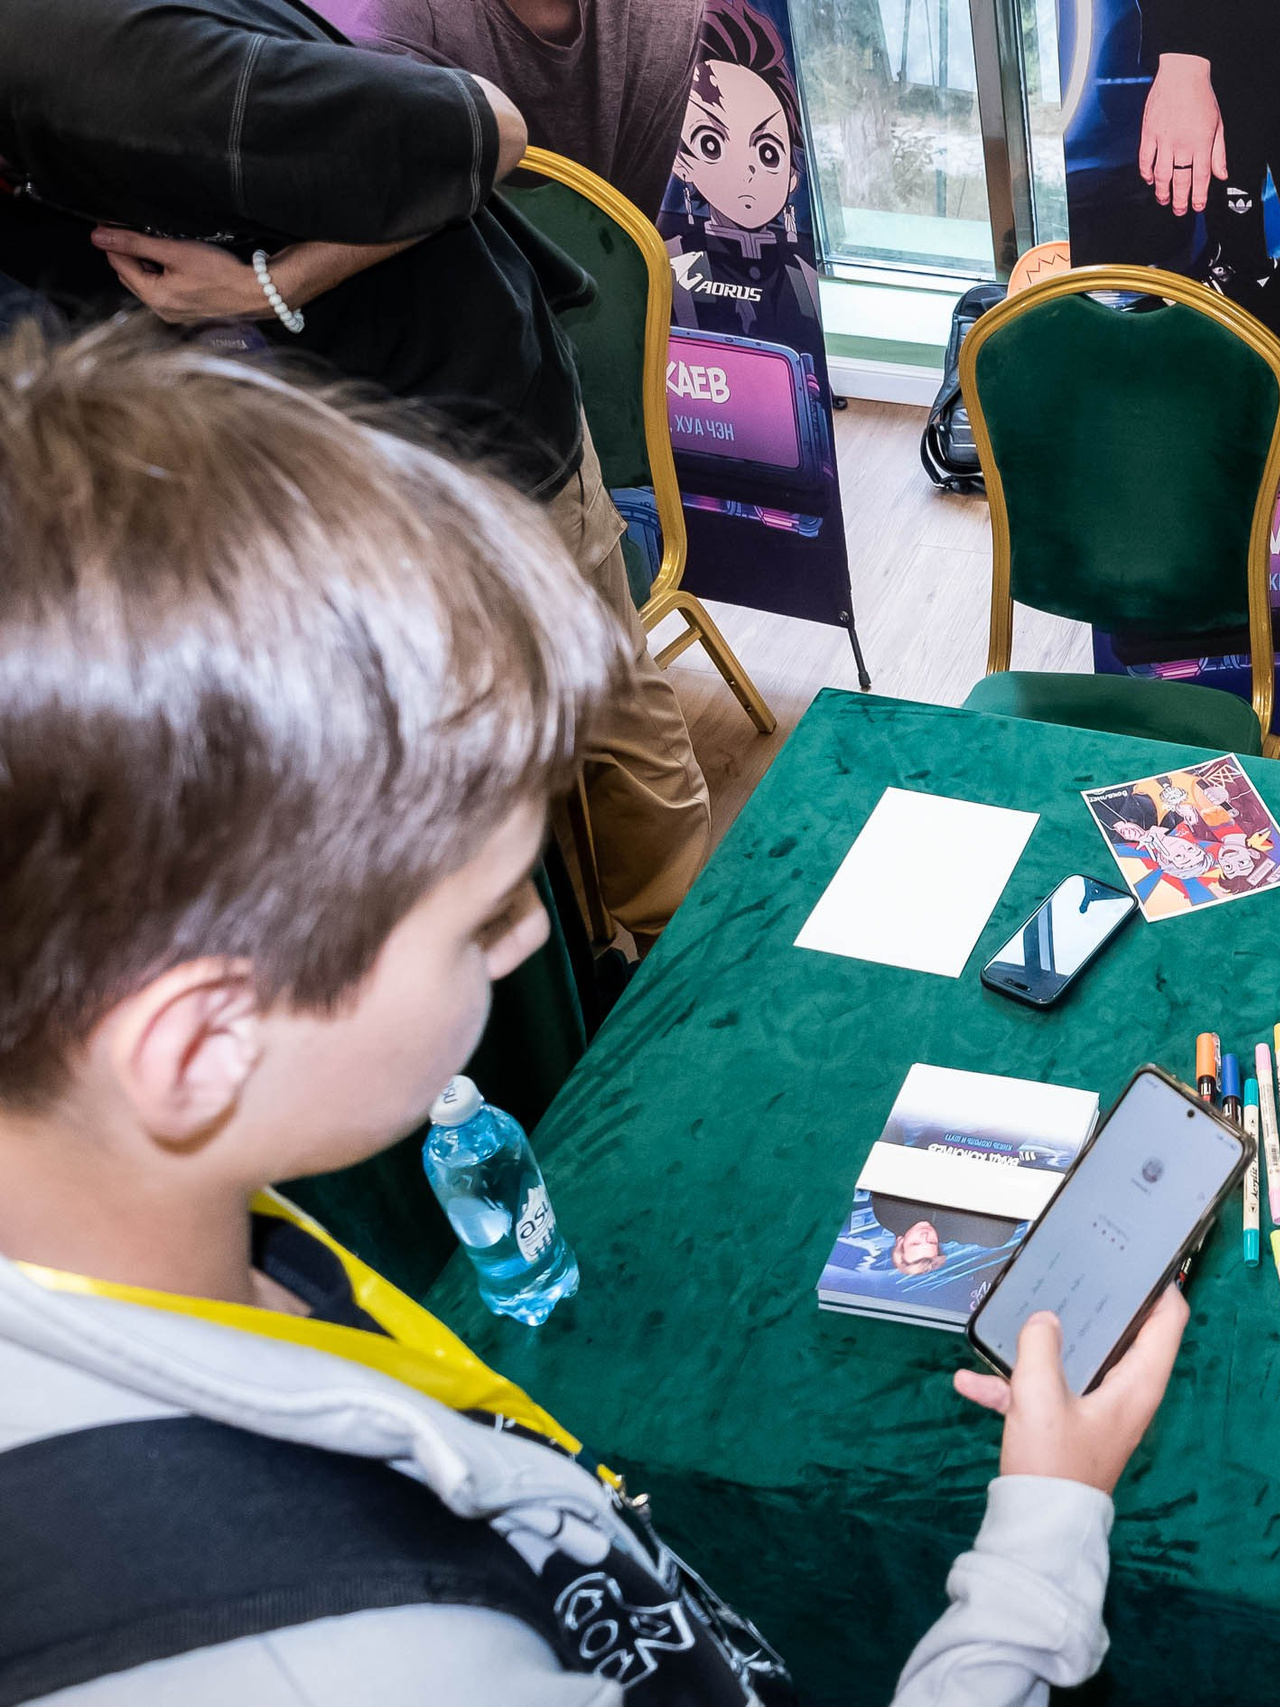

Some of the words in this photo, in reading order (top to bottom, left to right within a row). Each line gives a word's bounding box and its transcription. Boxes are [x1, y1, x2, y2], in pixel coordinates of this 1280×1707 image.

[695, 281, 763, 302] AORUS
[674, 413, 704, 437] ХУА
[707, 417, 735, 442] ЧЭН
